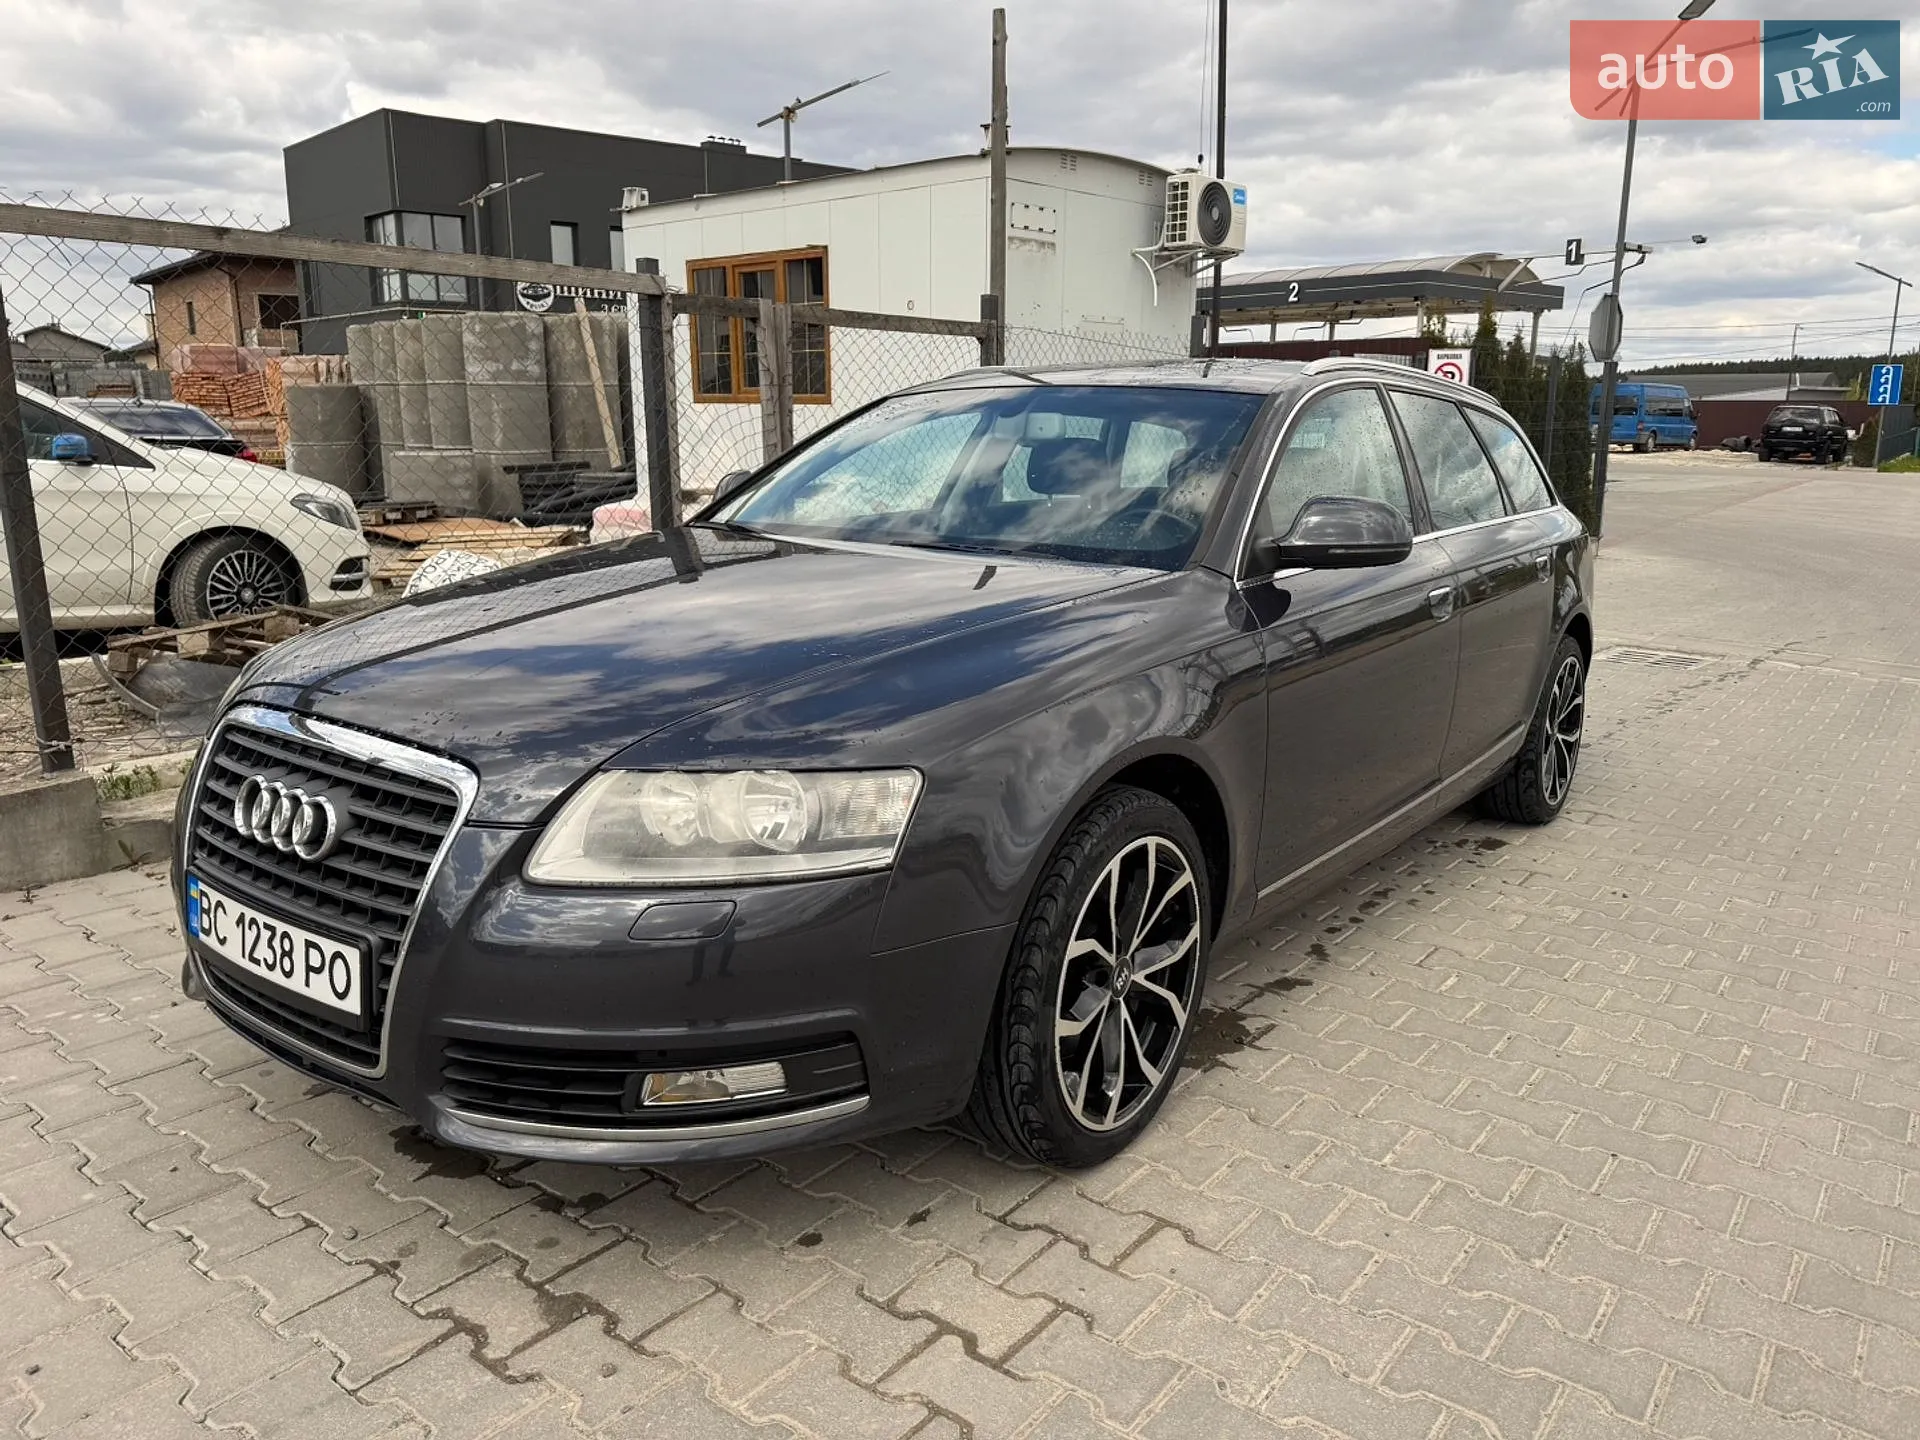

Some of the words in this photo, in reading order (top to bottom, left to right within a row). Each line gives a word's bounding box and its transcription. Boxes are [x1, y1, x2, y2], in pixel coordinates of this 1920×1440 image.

[1568, 241, 1577, 262] 1
[1288, 282, 1299, 302] 2
[199, 889, 227, 946] BC
[235, 912, 294, 979] 1238
[304, 938, 352, 1001] PO
